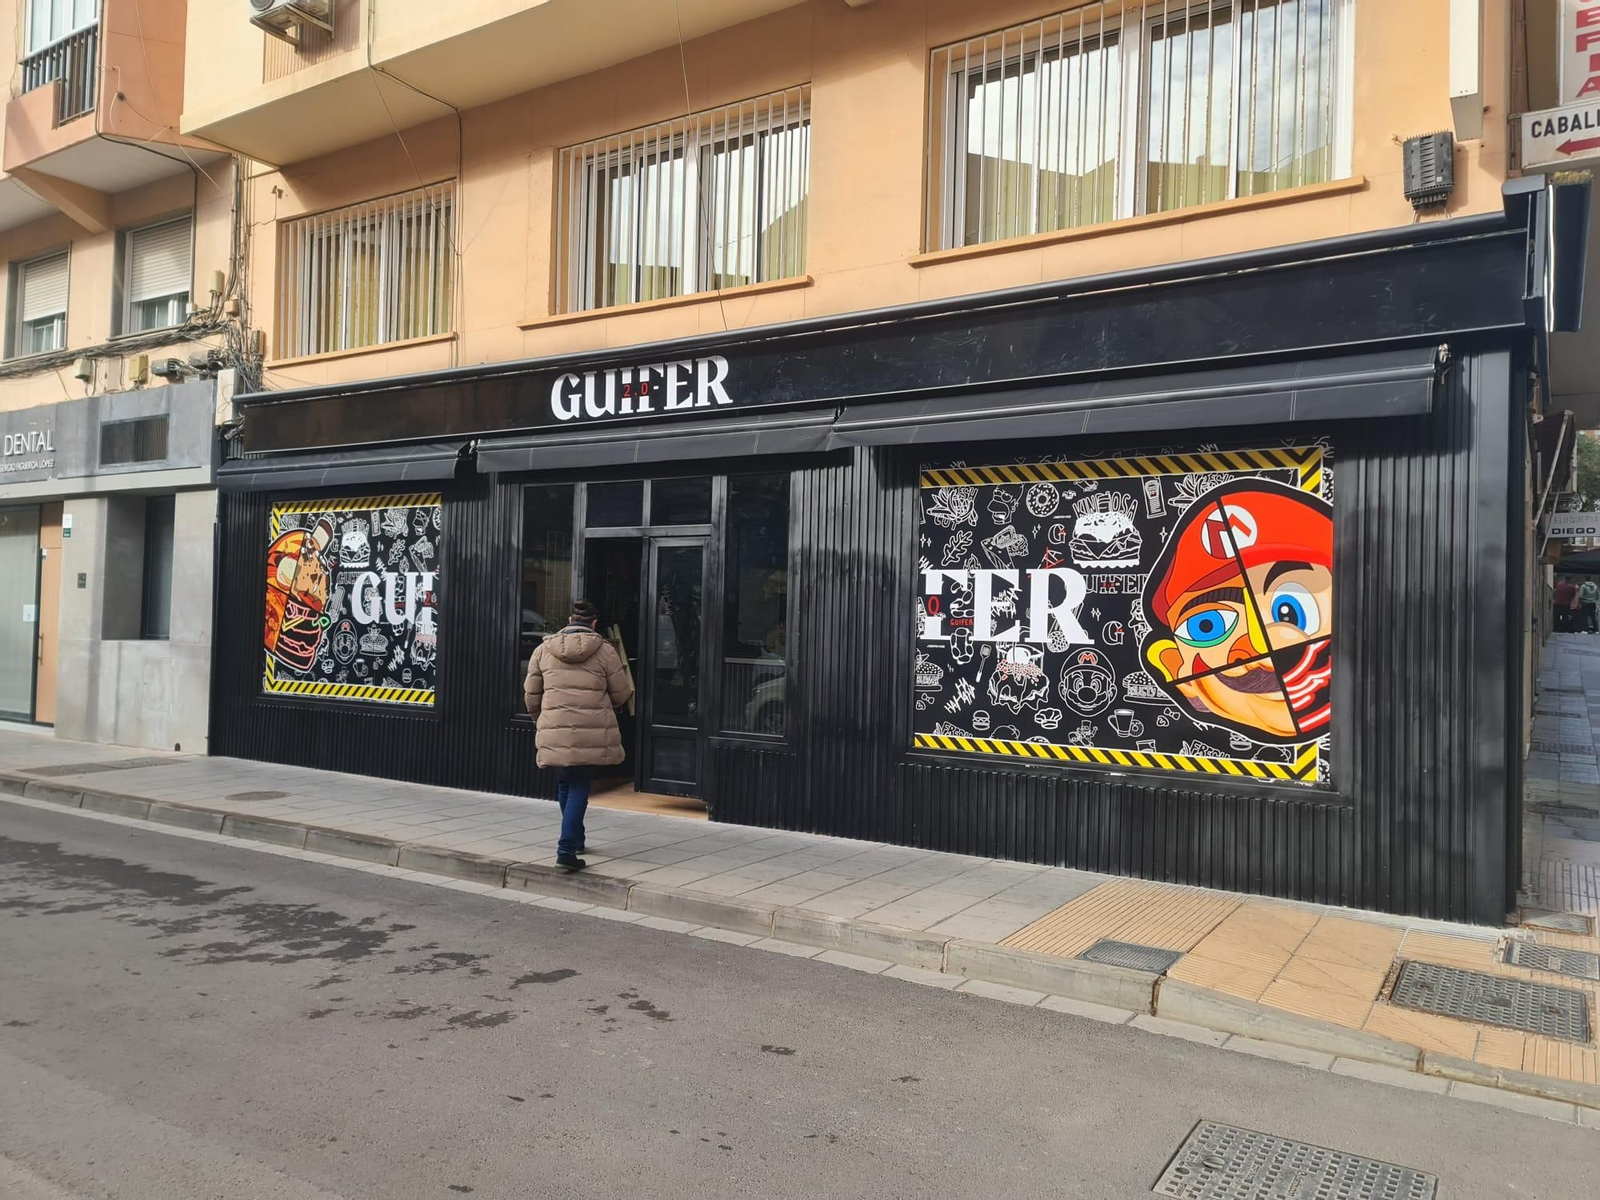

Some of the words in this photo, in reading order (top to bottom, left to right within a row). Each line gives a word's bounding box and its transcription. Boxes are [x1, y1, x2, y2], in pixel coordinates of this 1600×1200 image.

[551, 355, 733, 421] GUIFER
[623, 382, 650, 397] 2.0
[4, 428, 55, 456] DENTAL
[1551, 527, 1596, 535] DIEGO
